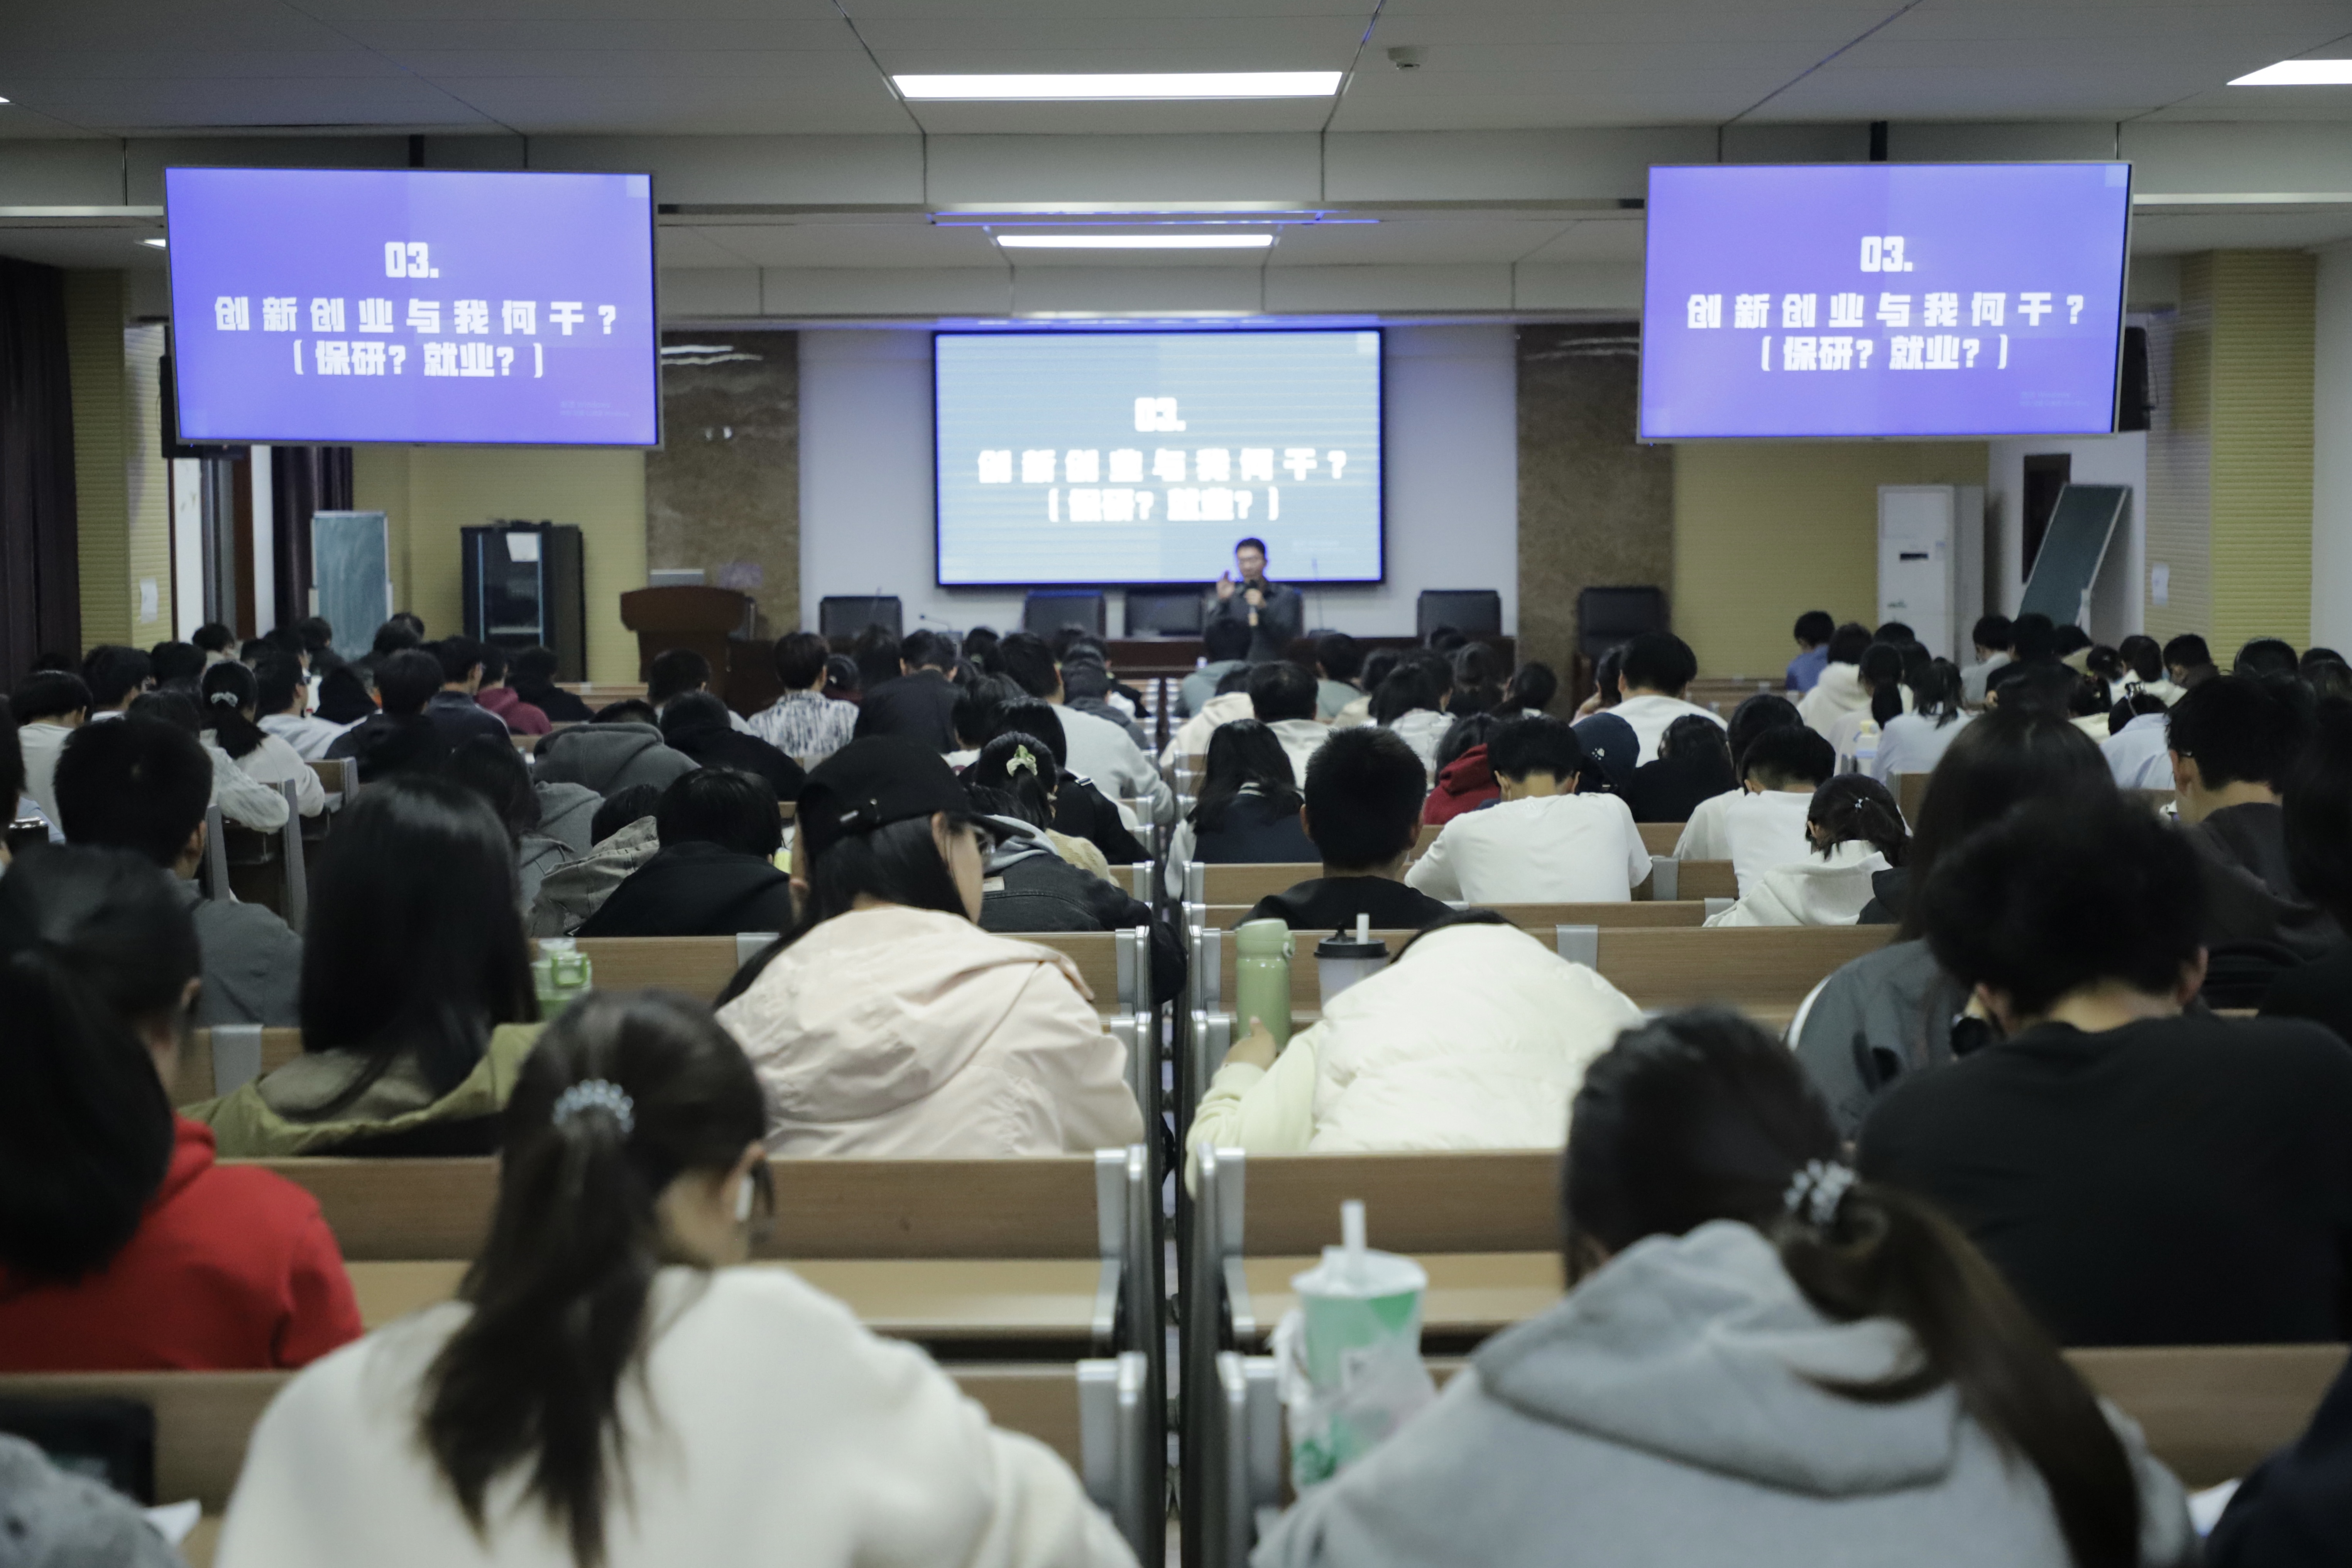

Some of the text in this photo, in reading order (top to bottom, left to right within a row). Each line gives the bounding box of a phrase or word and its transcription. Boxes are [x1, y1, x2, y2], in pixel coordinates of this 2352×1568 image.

[385, 242, 440, 279] 03.
[1861, 236, 1914, 272] 03.
[215, 296, 617, 336] 创新创业与我何干？
[1687, 292, 2084, 329] 创新创业与我何干？
